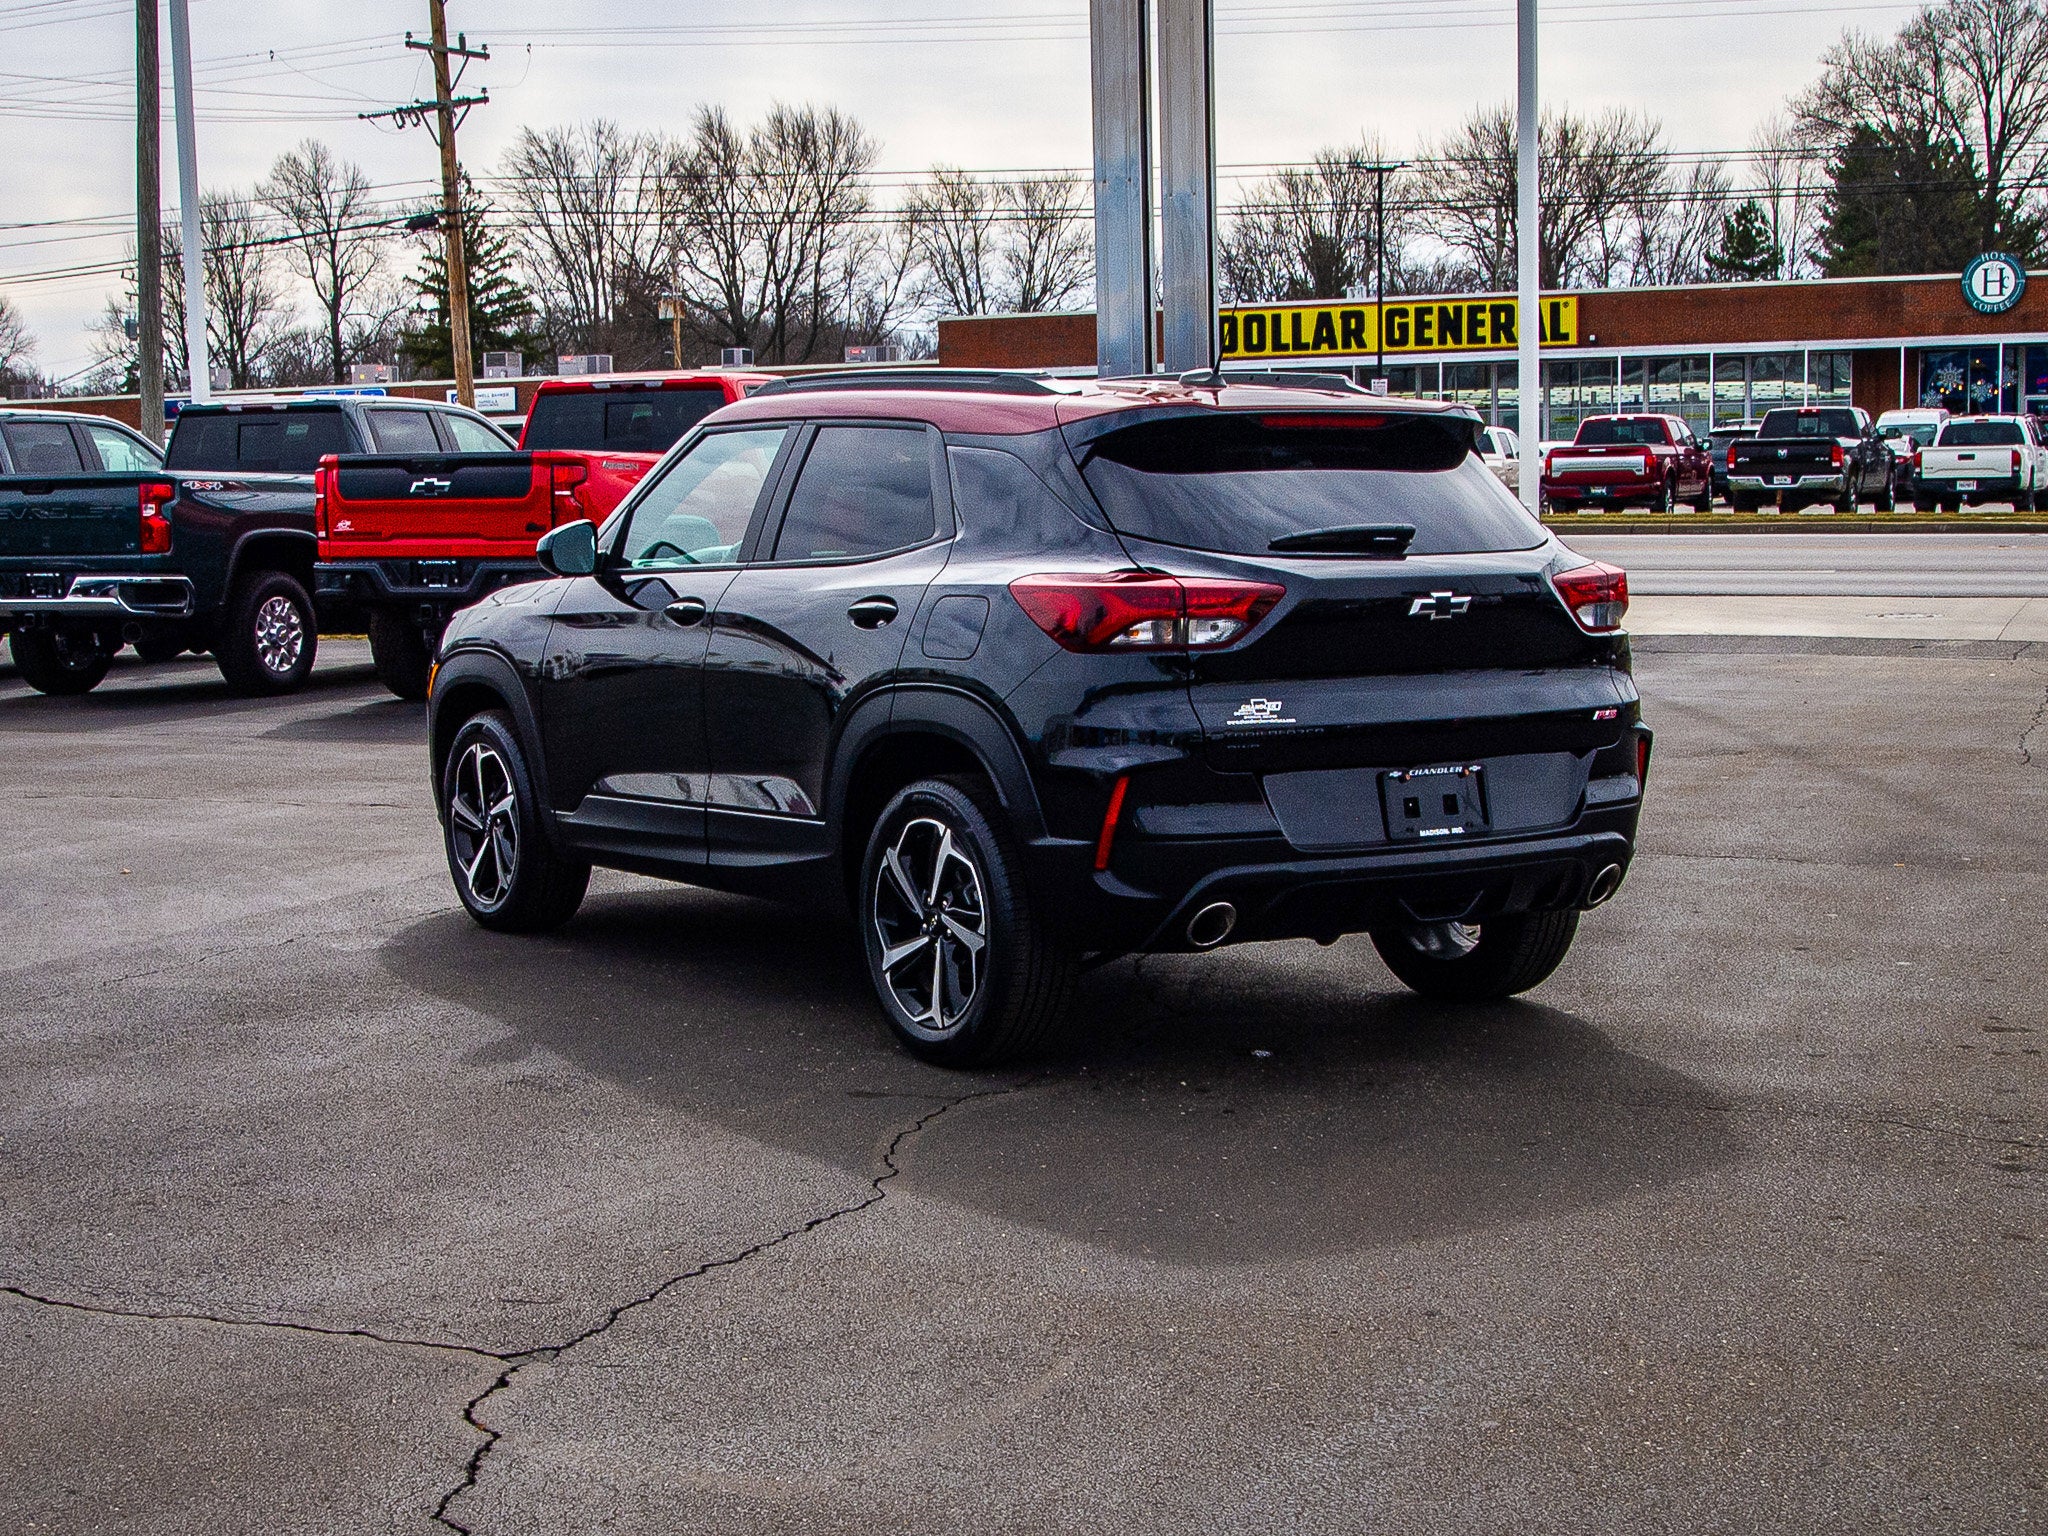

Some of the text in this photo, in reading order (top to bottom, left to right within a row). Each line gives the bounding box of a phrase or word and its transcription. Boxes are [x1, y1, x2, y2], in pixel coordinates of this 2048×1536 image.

[1980, 251, 2007, 262] HOS
[1972, 298, 2014, 313] COFFEE
[1219, 301, 1569, 353] DOLLAR GENERL
[1408, 765, 1464, 777] CHANDLER
